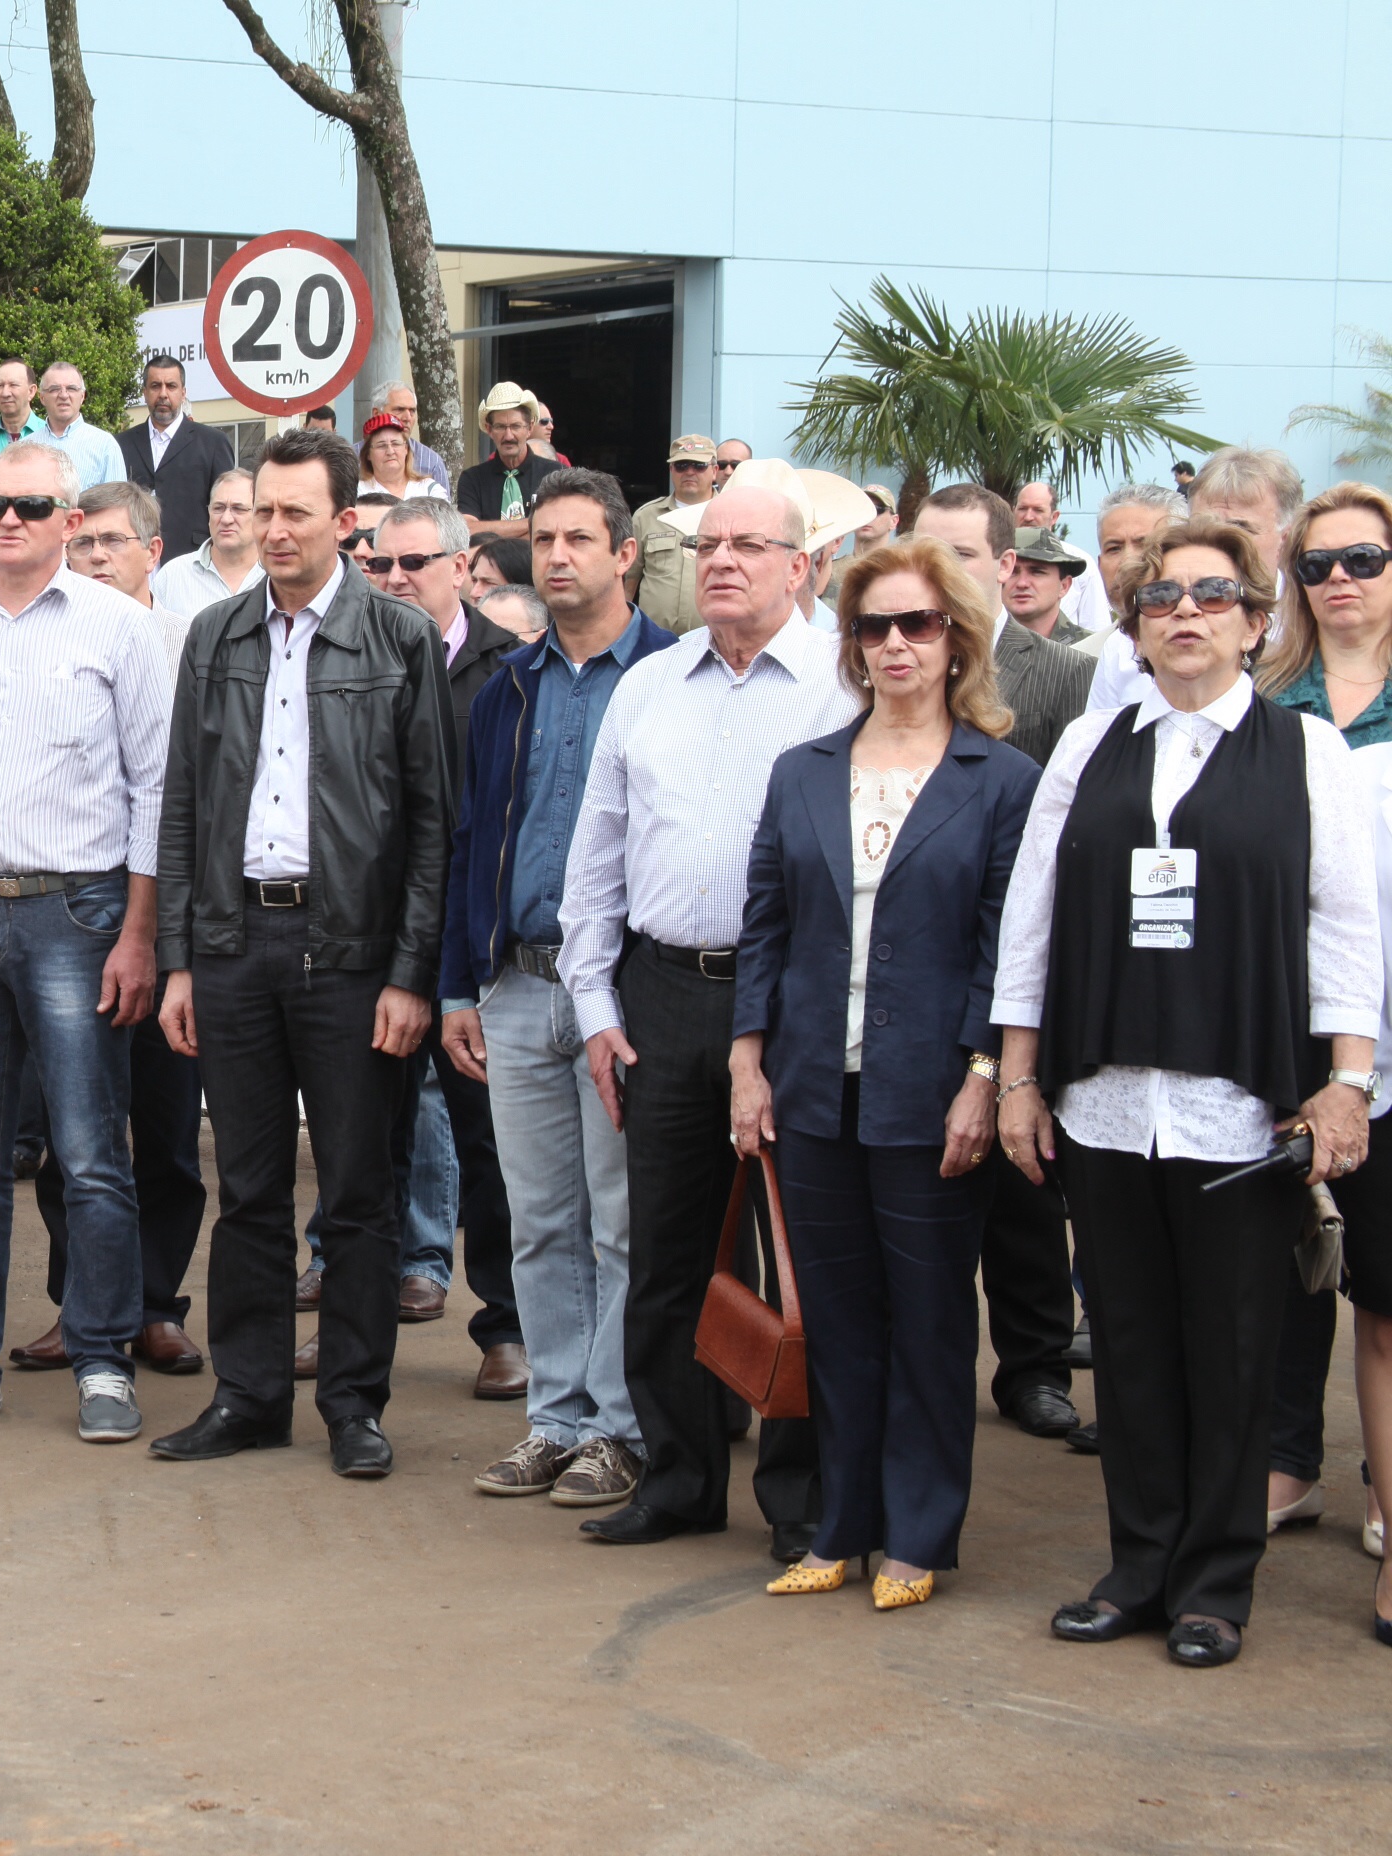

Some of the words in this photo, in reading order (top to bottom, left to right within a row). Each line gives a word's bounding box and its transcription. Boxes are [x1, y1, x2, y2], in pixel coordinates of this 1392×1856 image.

[230, 273, 345, 363] 20
[179, 344, 195, 362] DE
[265, 368, 310, 385] km/h
[1148, 871, 1176, 887] efapi
